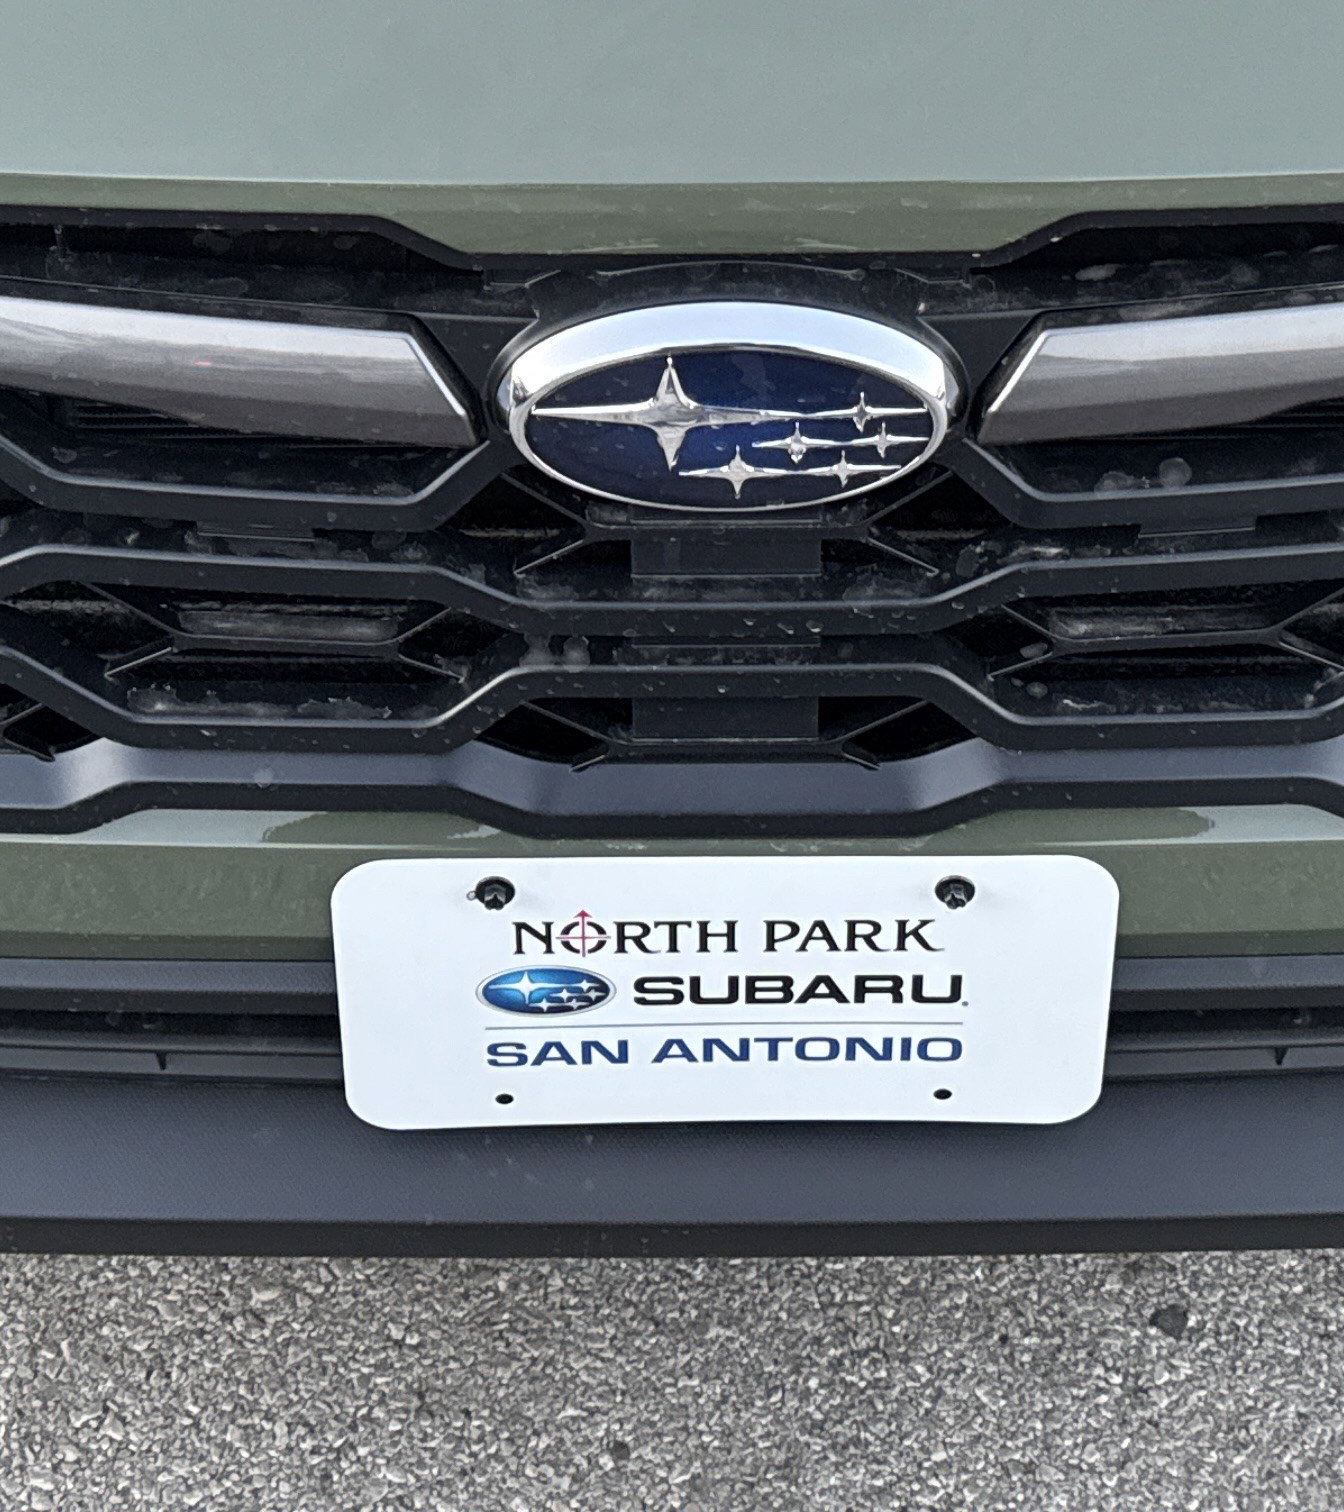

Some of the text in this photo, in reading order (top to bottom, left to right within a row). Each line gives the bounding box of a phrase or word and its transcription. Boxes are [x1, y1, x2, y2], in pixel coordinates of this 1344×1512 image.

[512, 915, 945, 956] NORTH PARK
[633, 974, 963, 1006] SUBARU
[486, 1036, 963, 1067] SAN ANTONIO
